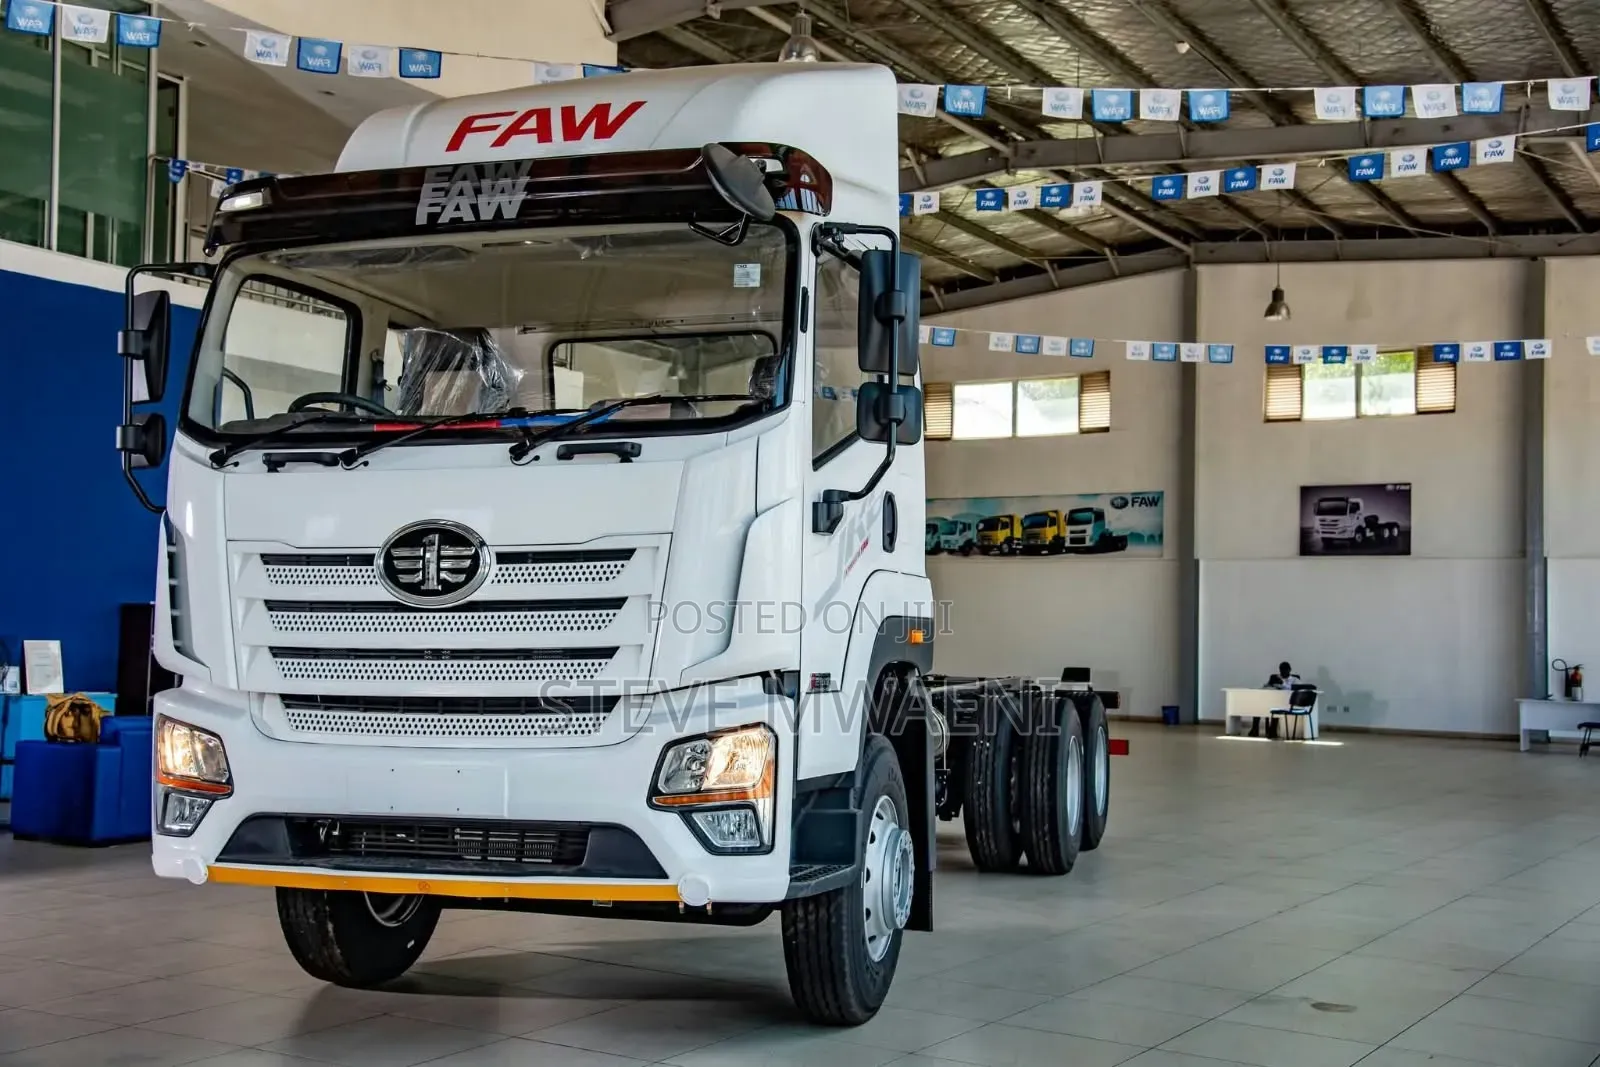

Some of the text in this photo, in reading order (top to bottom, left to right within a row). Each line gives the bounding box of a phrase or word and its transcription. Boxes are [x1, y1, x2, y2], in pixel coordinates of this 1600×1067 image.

[445, 101, 648, 152] FAW
[1484, 148, 1505, 160] FAW
[1398, 161, 1418, 172] FAW
[1441, 156, 1462, 168] FAW
[1355, 167, 1376, 177] FAW
[1230, 179, 1249, 189] FAW
[1268, 177, 1287, 185] FAW
[1158, 188, 1175, 197] FAW
[1195, 185, 1212, 193] FAW
[980, 200, 997, 208] FAW
[1045, 195, 1062, 204] FAW
[415, 191, 528, 226] FAW
[1131, 496, 1161, 508] FAW
